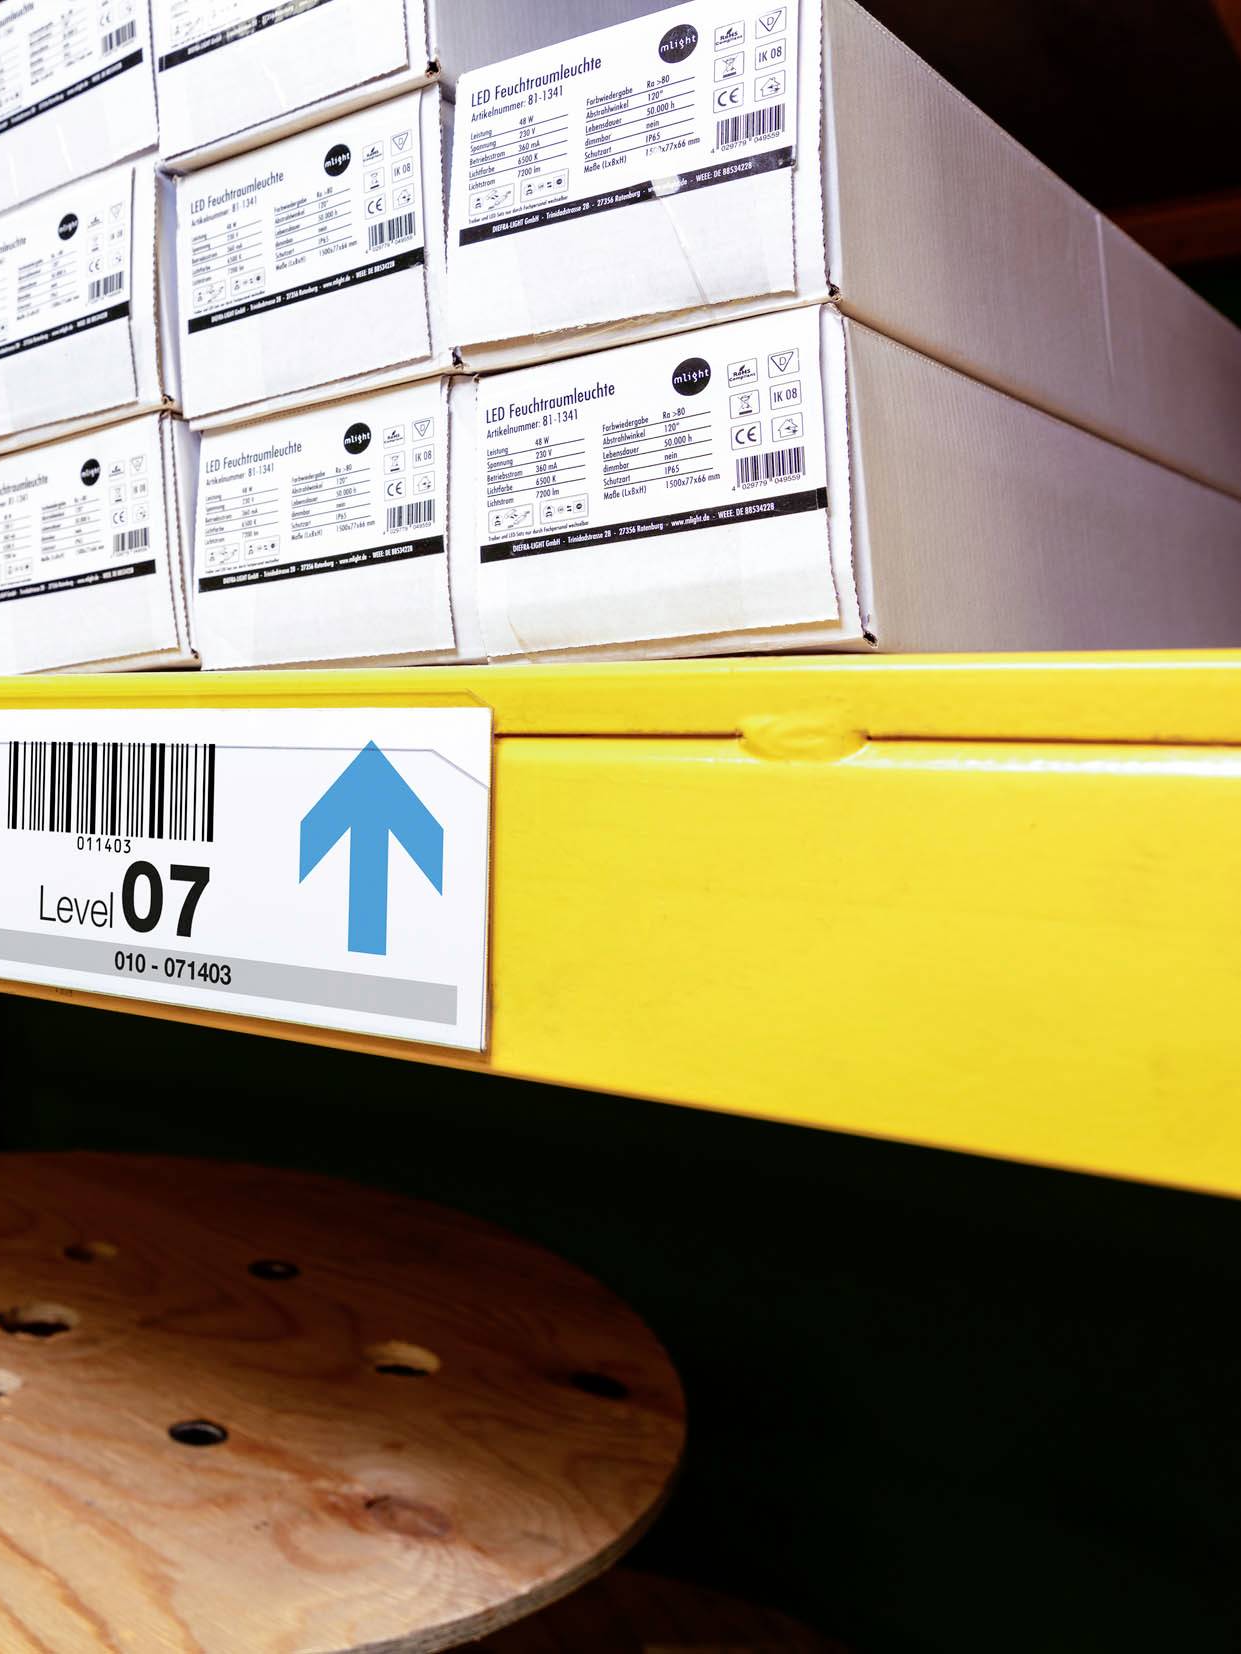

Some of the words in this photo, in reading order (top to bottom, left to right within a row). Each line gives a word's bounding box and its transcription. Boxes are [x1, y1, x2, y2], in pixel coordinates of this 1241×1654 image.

[659, 34, 696, 56] mlight
[759, 50, 768, 63] IK
[770, 46, 782, 59] 08
[471, 89, 490, 107] LED
[495, 57, 601, 100] Feuchtraumleuchte
[528, 85, 563, 105] 81-1341
[586, 86, 633, 109] Farbwiedergabe
[647, 80, 655, 88] Ra
[585, 118, 622, 134] Lebensdauer
[647, 102, 669, 116] 50.000
[586, 99, 629, 119] Abstrahlwinkel
[470, 129, 492, 142] Leistung
[519, 117, 526, 125] 48
[519, 129, 530, 139] 230
[584, 134, 611, 146] dimmbar
[646, 119, 660, 129] nein
[518, 142, 530, 152] 360
[530, 140, 540, 148] mA
[584, 146, 612, 160] Schutzart
[646, 132, 661, 143] IP65
[688, 137, 700, 146] mm
[324, 152, 349, 171] mlight
[394, 167, 400, 176] IK
[402, 163, 411, 174] 08
[518, 154, 533, 165] 6500
[468, 179, 495, 191] Lichtstrom
[517, 167, 532, 178] 7200
[191, 199, 205, 215] LED
[208, 171, 283, 208] Feuchtraumleuchte
[524, 215, 539, 225] GmbH
[597, 196, 614, 207] 27356
[714, 169, 721, 178] DE
[673, 369, 709, 388] mlight
[486, 406, 505, 424] LED
[509, 382, 615, 419] Feuchtraumleuchte
[774, 391, 783, 403] IK
[786, 387, 797, 400] 08
[542, 408, 578, 427] 81-1341
[602, 416, 649, 435] Farbwiedergabe
[662, 411, 670, 419] Ra
[344, 432, 370, 447] mlight
[603, 429, 646, 445] Abstrahlwinkel
[206, 459, 220, 474] LED
[223, 441, 302, 469] Feuchtraumleuchte
[415, 453, 421, 462] IK
[423, 450, 432, 460] 08
[487, 447, 509, 459] Leistung
[535, 438, 542, 446] 48
[535, 450, 547, 459] 230
[602, 447, 639, 460] Lebensdauer
[664, 435, 686, 447] 50.000
[536, 464, 547, 473] 360
[548, 462, 558, 470] mA
[603, 461, 629, 473] dimmbar
[664, 451, 678, 461] nein
[536, 475, 551, 486] 6500
[603, 475, 630, 487] Schutzart
[665, 464, 680, 474] IP65
[666, 474, 706, 489] 1500x77x66
[707, 473, 721, 481] mm
[487, 498, 514, 508] Lichtstrom
[536, 489, 551, 498] 7200
[552, 488, 560, 496] lm
[545, 538, 560, 547] GmbH
[619, 526, 636, 535] 27356
[736, 507, 744, 516] DE
[76, 835, 133, 854] 011403
[39, 884, 114, 928] Level
[121, 860, 211, 938] 07
[114, 950, 146, 974] 010
[163, 958, 232, 985] 071403
